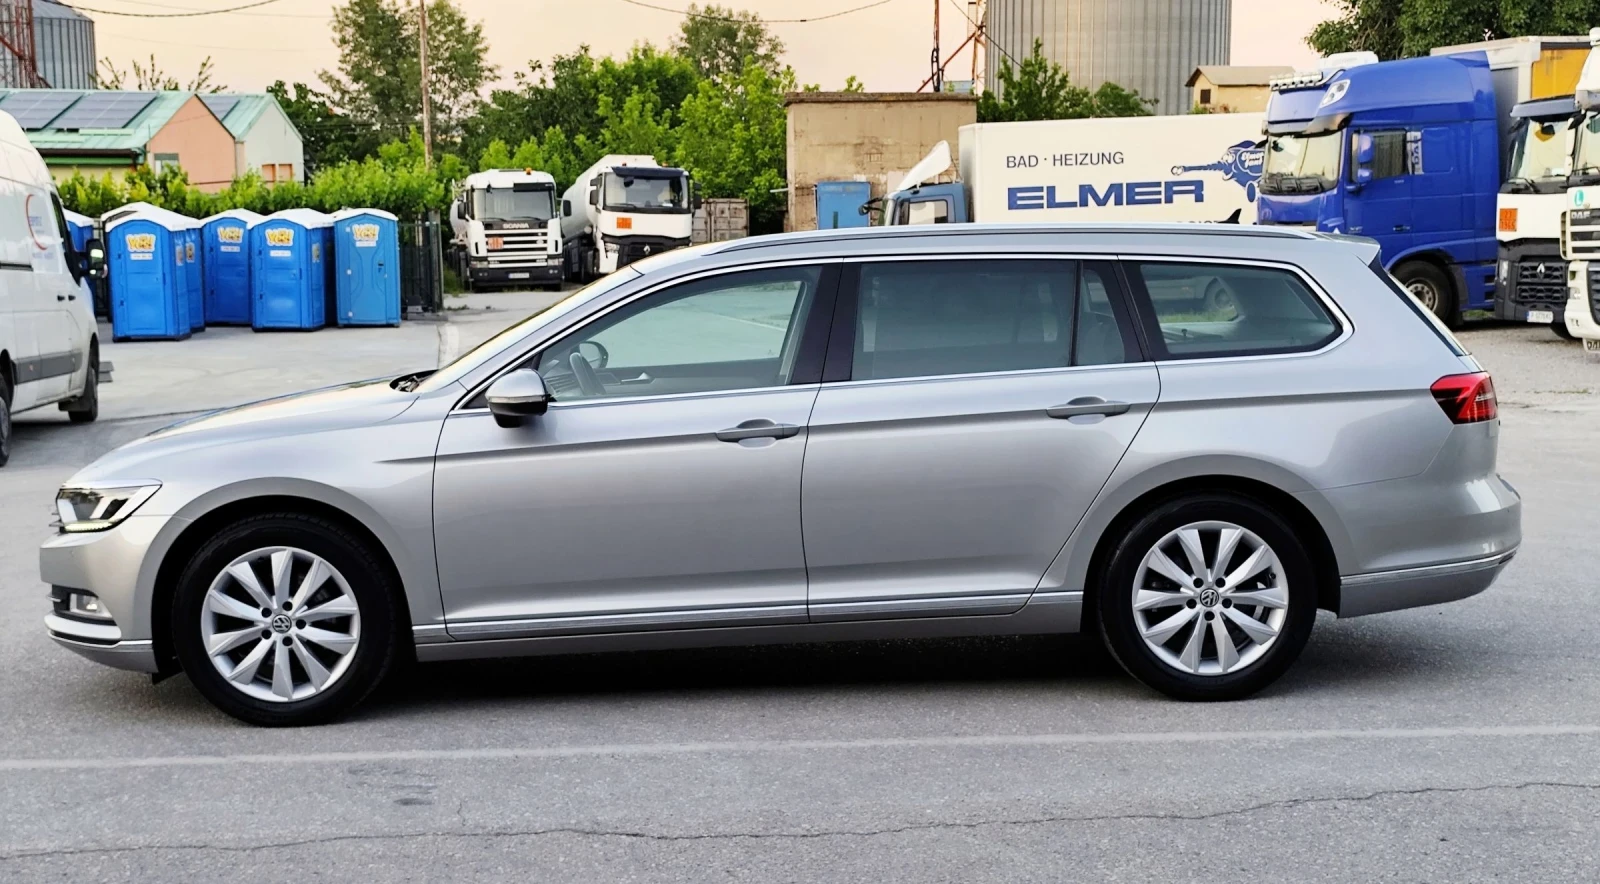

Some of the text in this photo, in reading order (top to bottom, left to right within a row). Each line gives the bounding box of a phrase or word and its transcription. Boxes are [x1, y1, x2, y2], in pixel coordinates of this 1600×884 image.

[1006, 155, 1039, 169] BAD
[1052, 151, 1125, 167] HEIZUNG
[1007, 179, 1205, 211] ELMER
[1570, 210, 1591, 220] DAF
